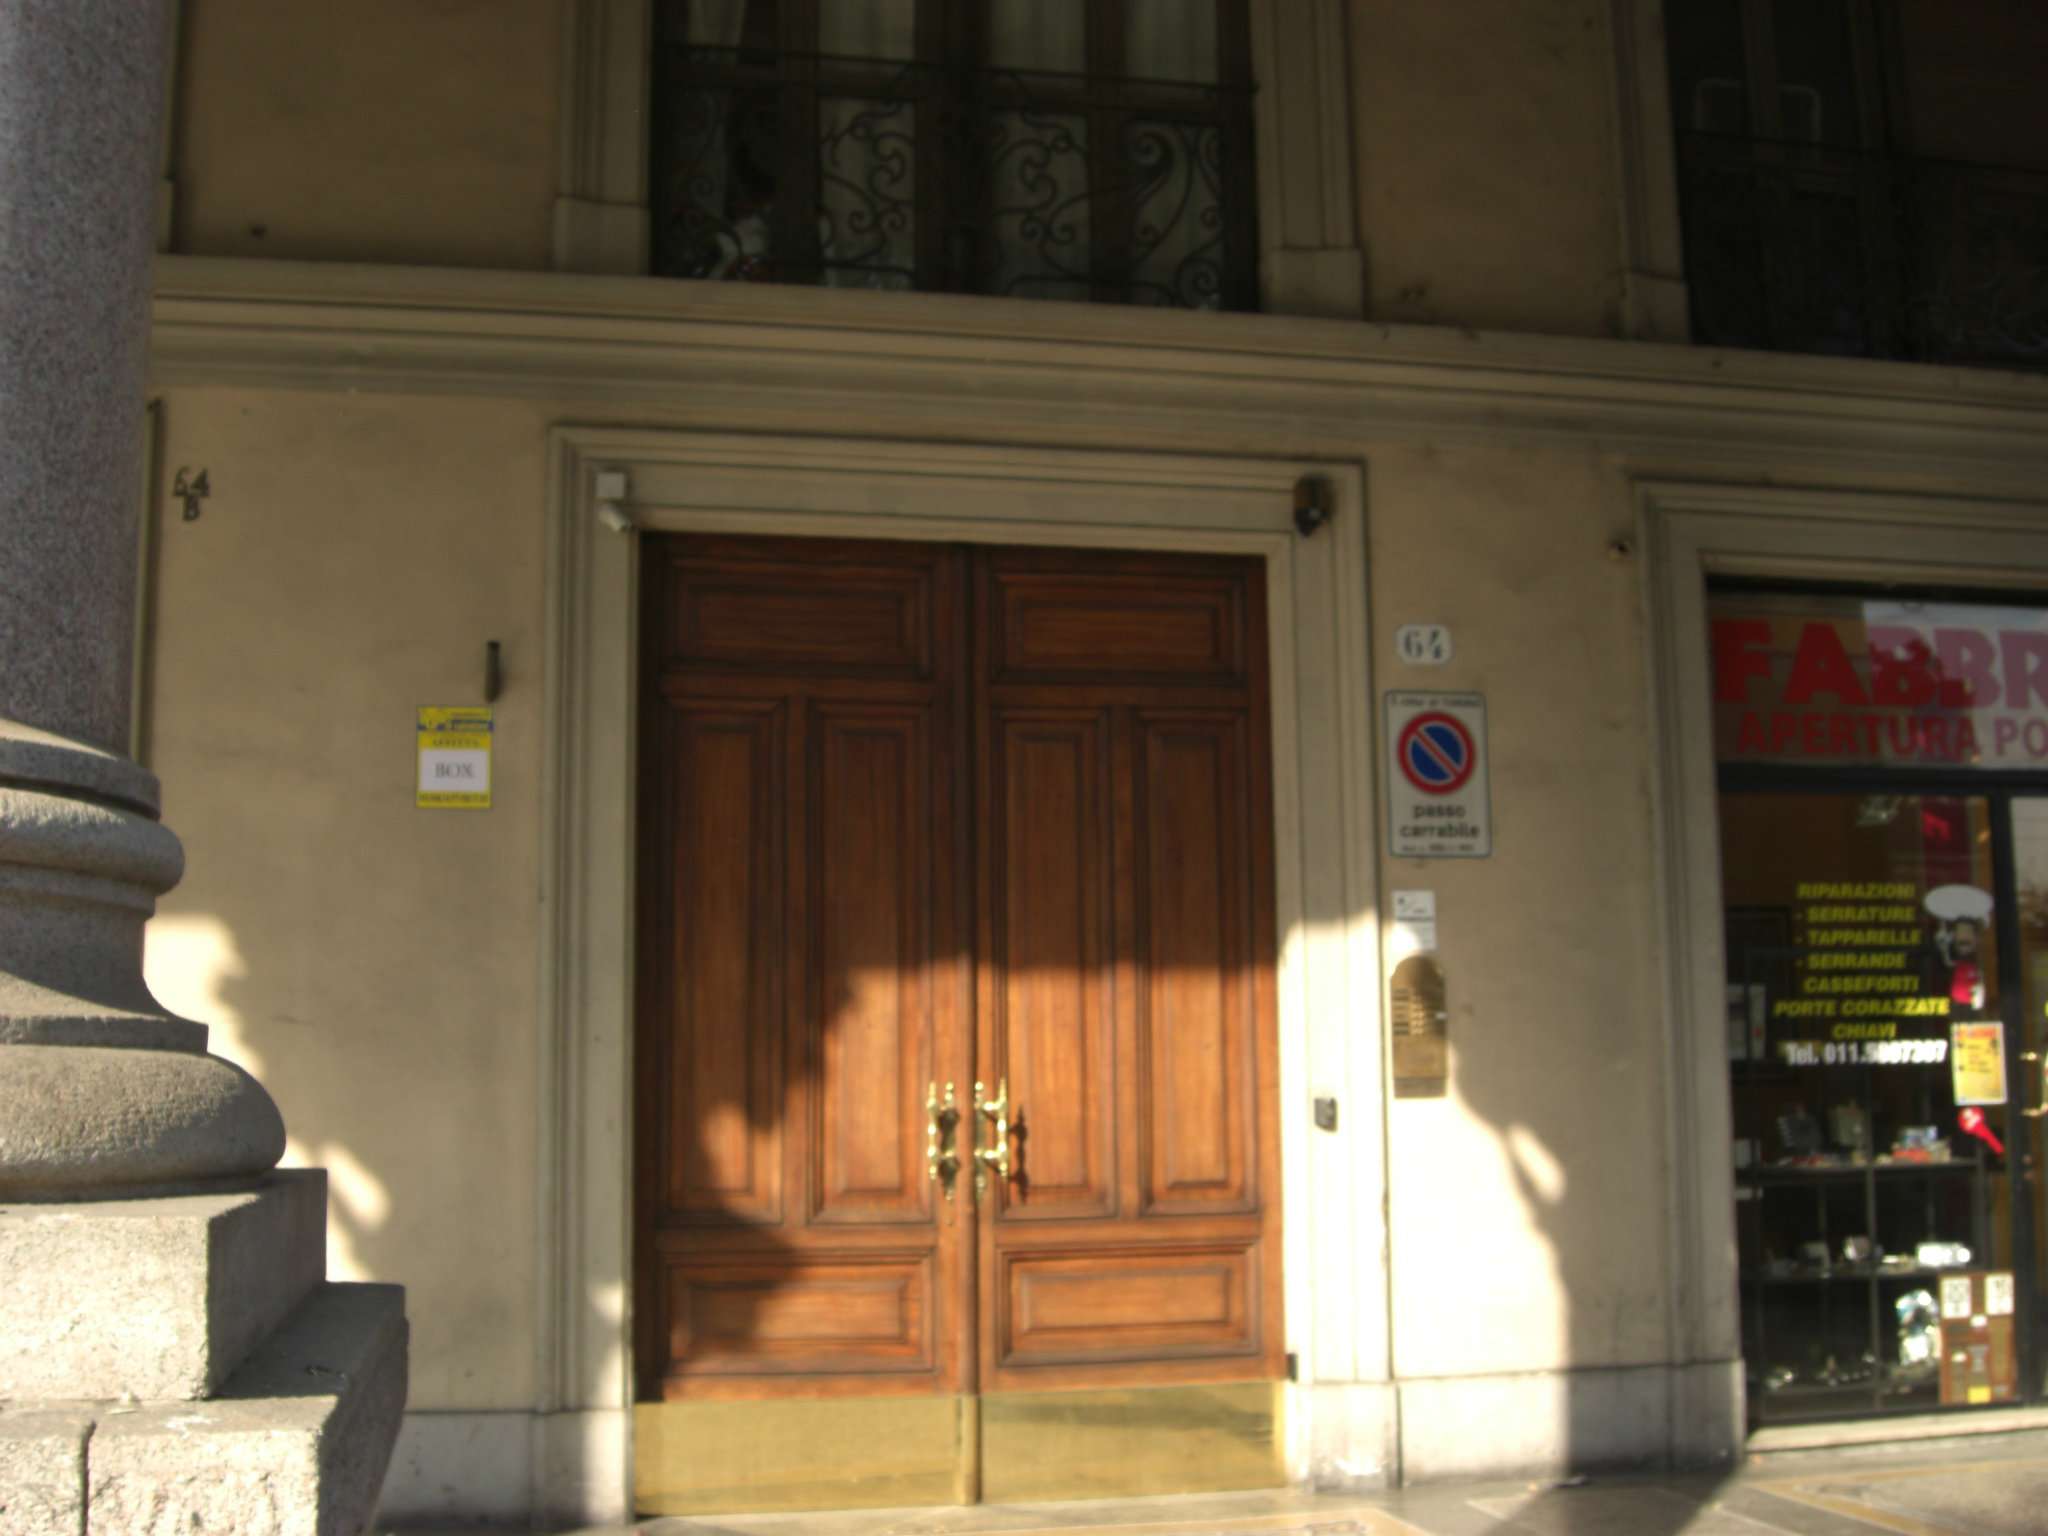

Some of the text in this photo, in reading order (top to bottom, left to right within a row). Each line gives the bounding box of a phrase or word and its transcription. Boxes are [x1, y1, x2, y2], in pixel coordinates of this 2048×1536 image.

[1403, 628, 1443, 661] 64
[1740, 711, 1982, 761] APERTURA
[435, 762, 474, 779] BOX
[1412, 804, 1467, 820] passo
[1400, 822, 1480, 839] carrabile
[1797, 882, 1915, 899] RIPARAZIONI
[1807, 905, 1915, 923] SERRATURE
[1807, 928, 1921, 945] TAPPARELLE
[1807, 952, 1905, 970] SERRANDE
[1804, 975, 1919, 993] CASSEFORTI
[1773, 996, 1950, 1017] PORTE CORAZZATE
[1832, 1022, 1897, 1038] CHIAVI
